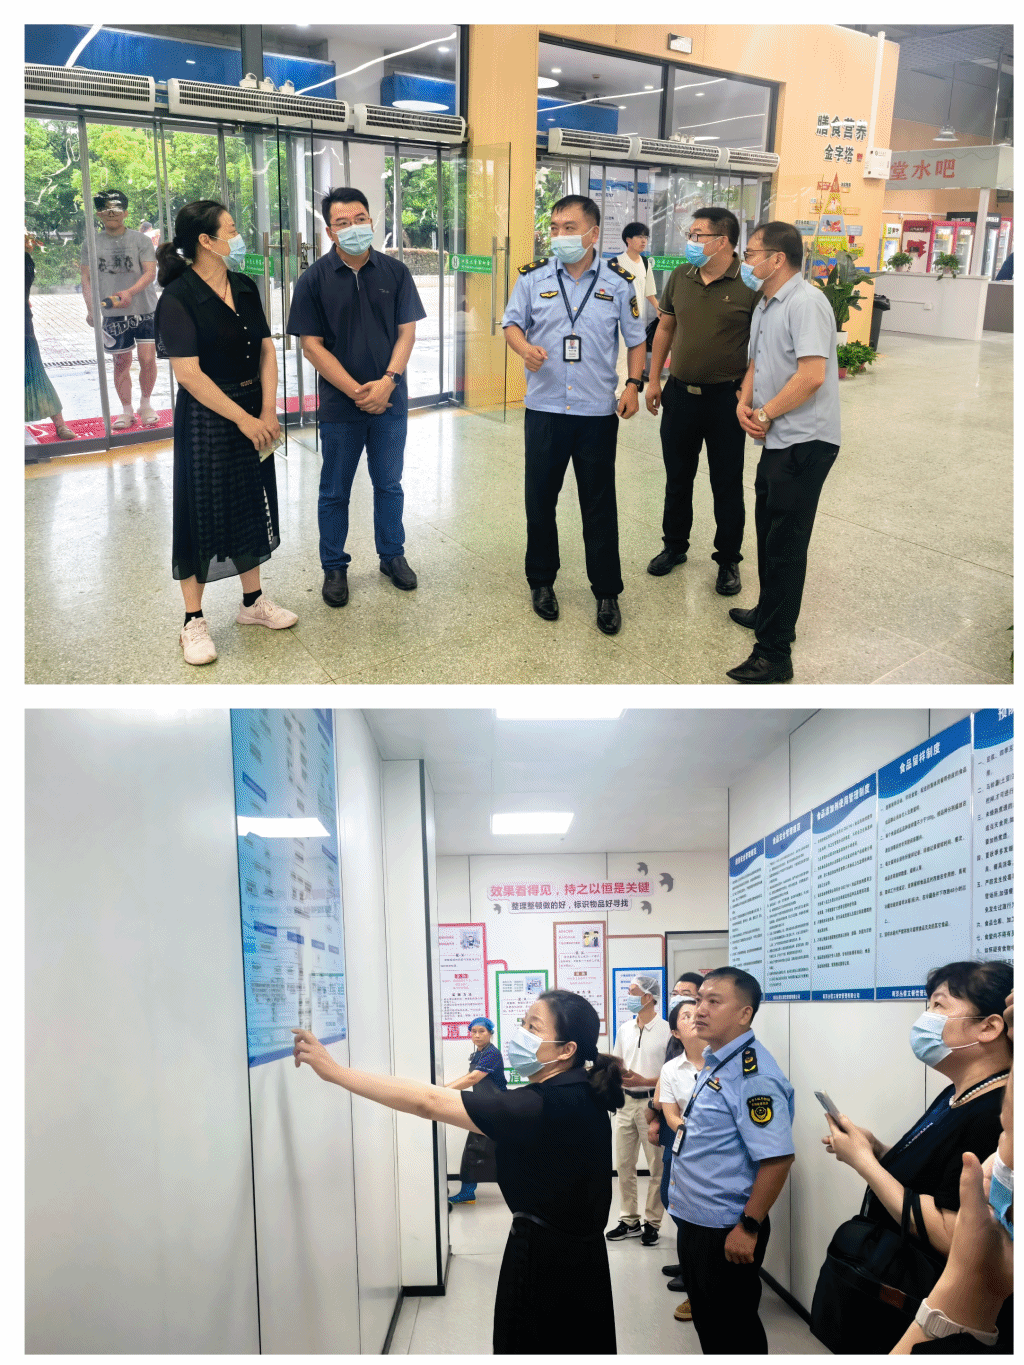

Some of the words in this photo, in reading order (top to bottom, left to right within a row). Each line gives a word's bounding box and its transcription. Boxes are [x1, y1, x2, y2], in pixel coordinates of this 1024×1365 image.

[824, 144, 855, 163] 金字塔
[899, 741, 941, 775] 食品留样制度
